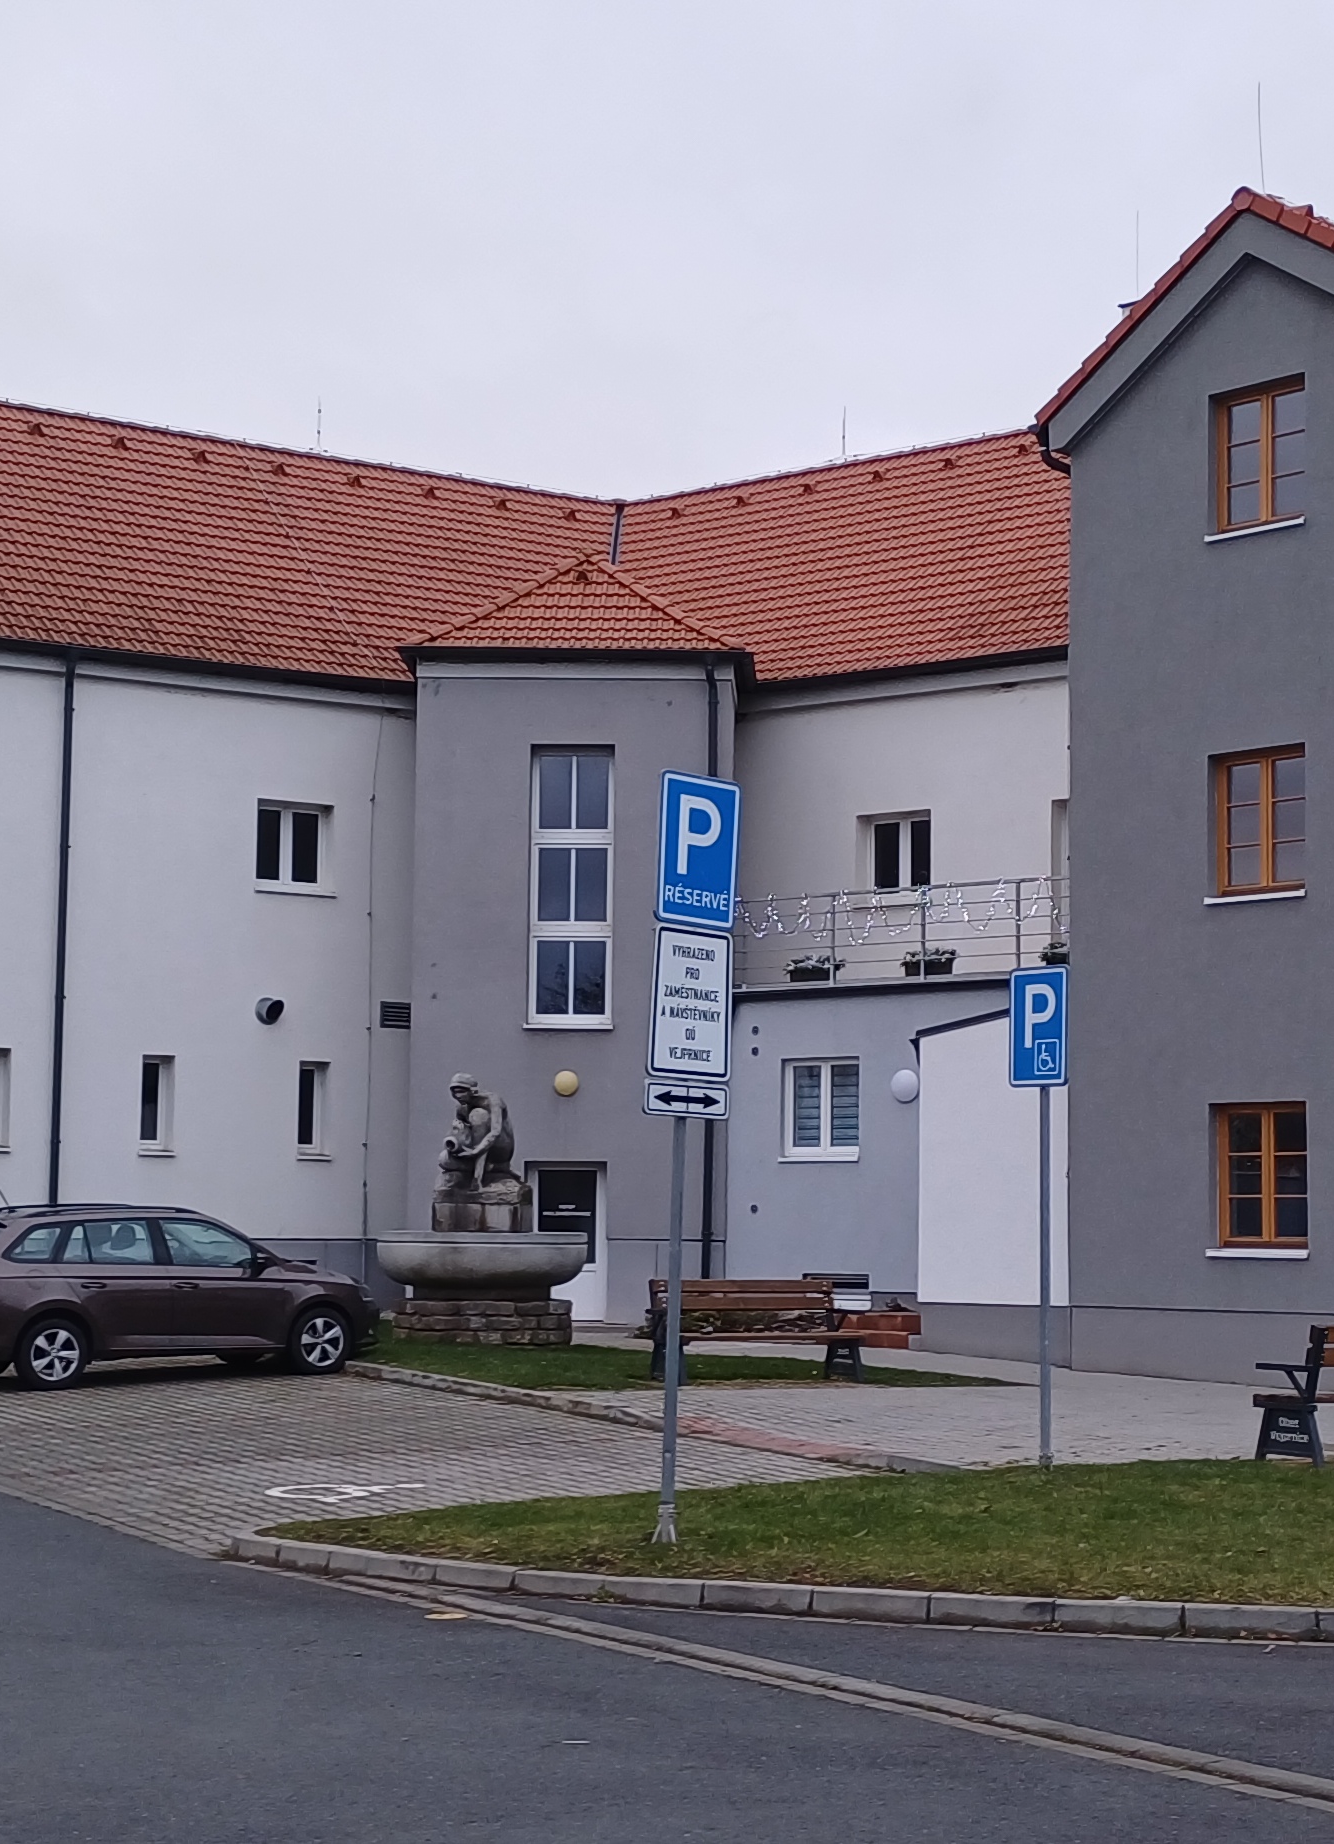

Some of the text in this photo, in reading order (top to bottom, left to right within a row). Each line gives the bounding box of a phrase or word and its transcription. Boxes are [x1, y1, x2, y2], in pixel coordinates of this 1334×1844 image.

[677, 793, 721, 875] P
[665, 883, 728, 910] RÉSERVÉ
[672, 944, 715, 962] VYHRAZENO
[685, 966, 700, 980] PRO
[664, 984, 720, 1003] ZAMĚSTNANCE
[660, 1003, 722, 1023] A NÁVŠTĚVNÍKY
[1024, 984, 1056, 1049] P
[668, 1046, 713, 1062] VEJPRNICE
